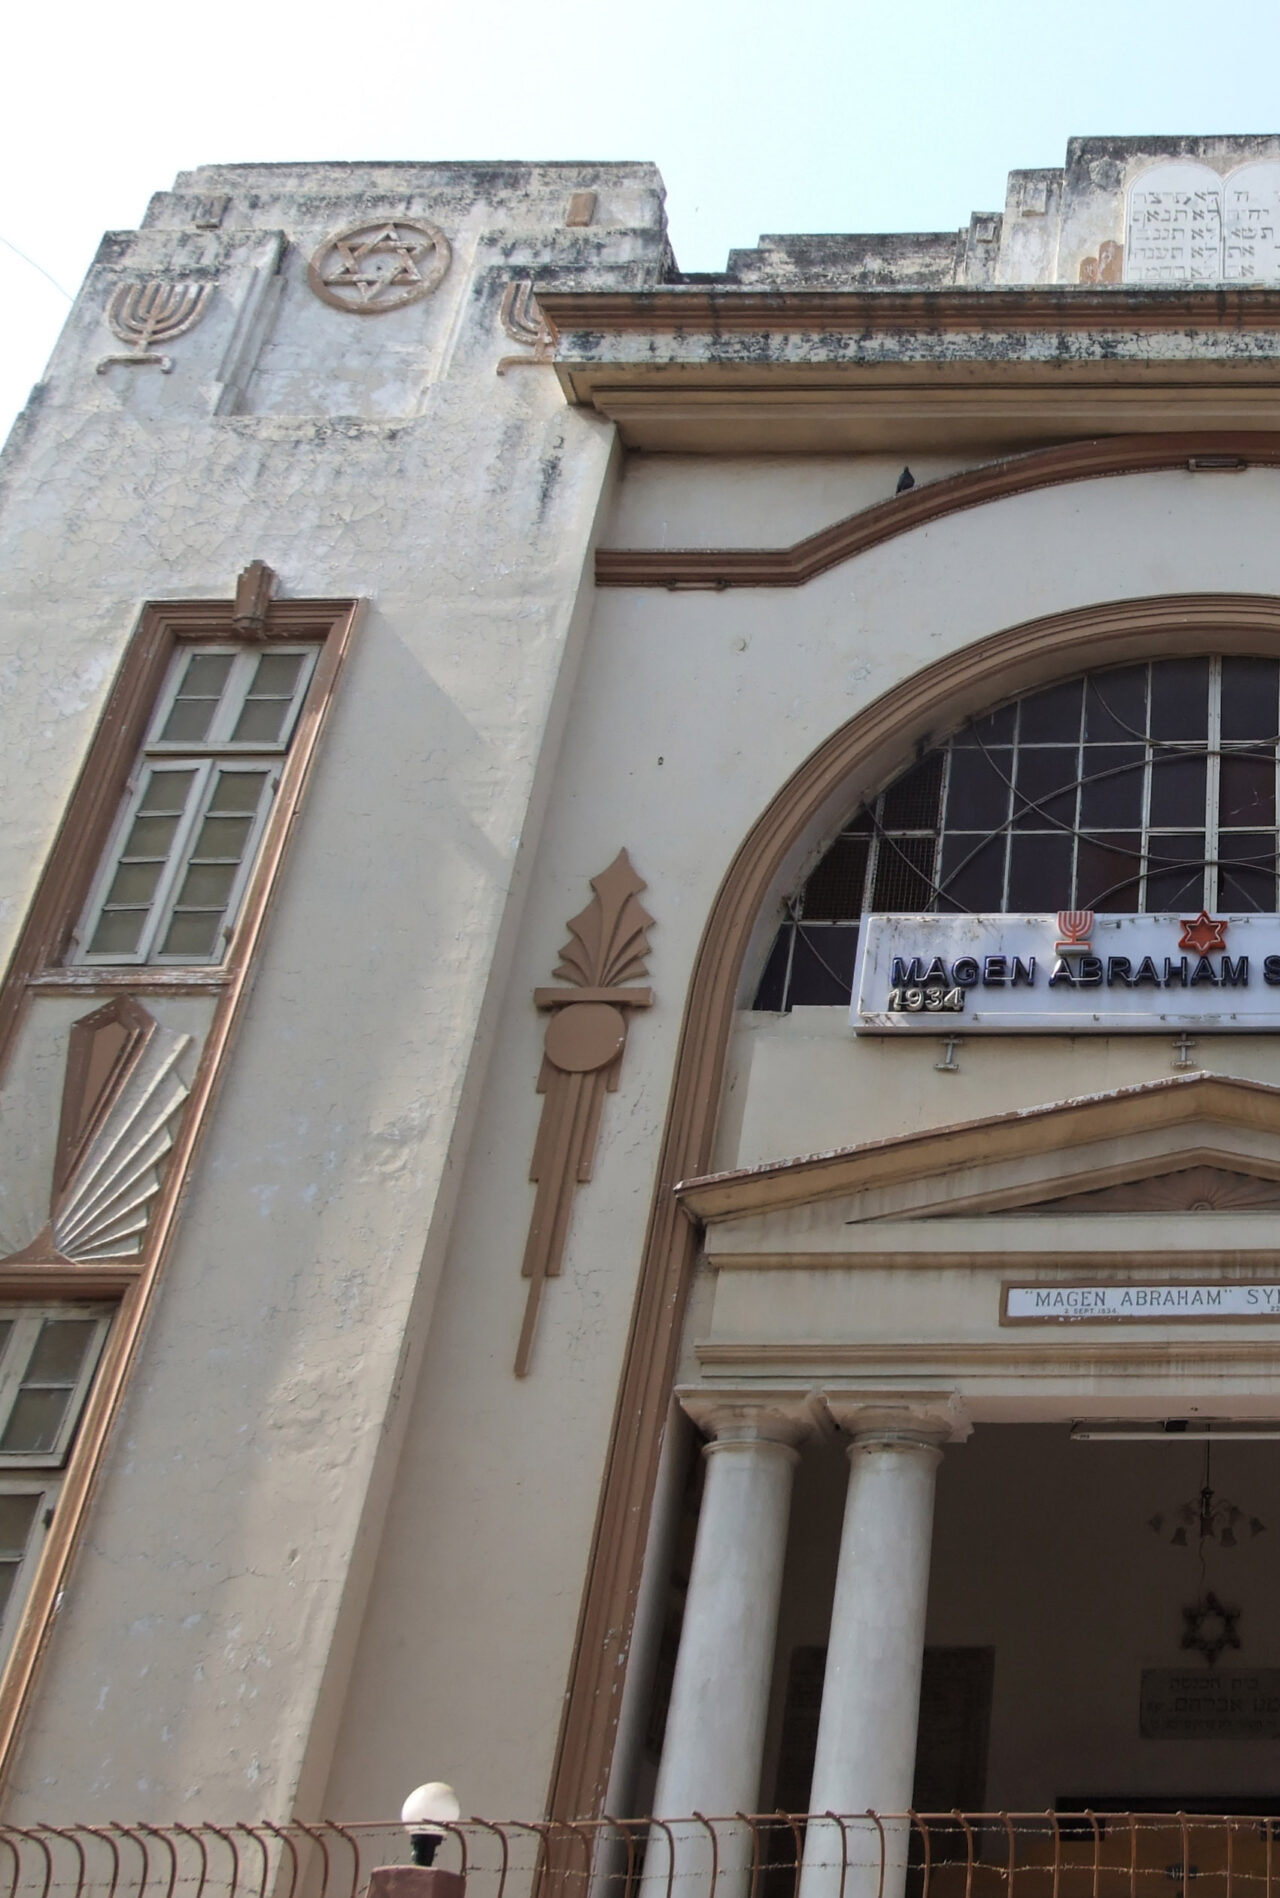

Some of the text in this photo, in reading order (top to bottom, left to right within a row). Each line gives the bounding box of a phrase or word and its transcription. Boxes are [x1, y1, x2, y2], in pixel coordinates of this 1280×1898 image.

[1192, 204, 1220, 221] לא
[1191, 223, 1216, 240] לא
[1191, 242, 1218, 261] לא
[1227, 245, 1255, 258] את
[890, 955, 1036, 988] MAGEN
[1048, 954, 1250, 988] ABRAHAM
[888, 986, 965, 1012] 1934
